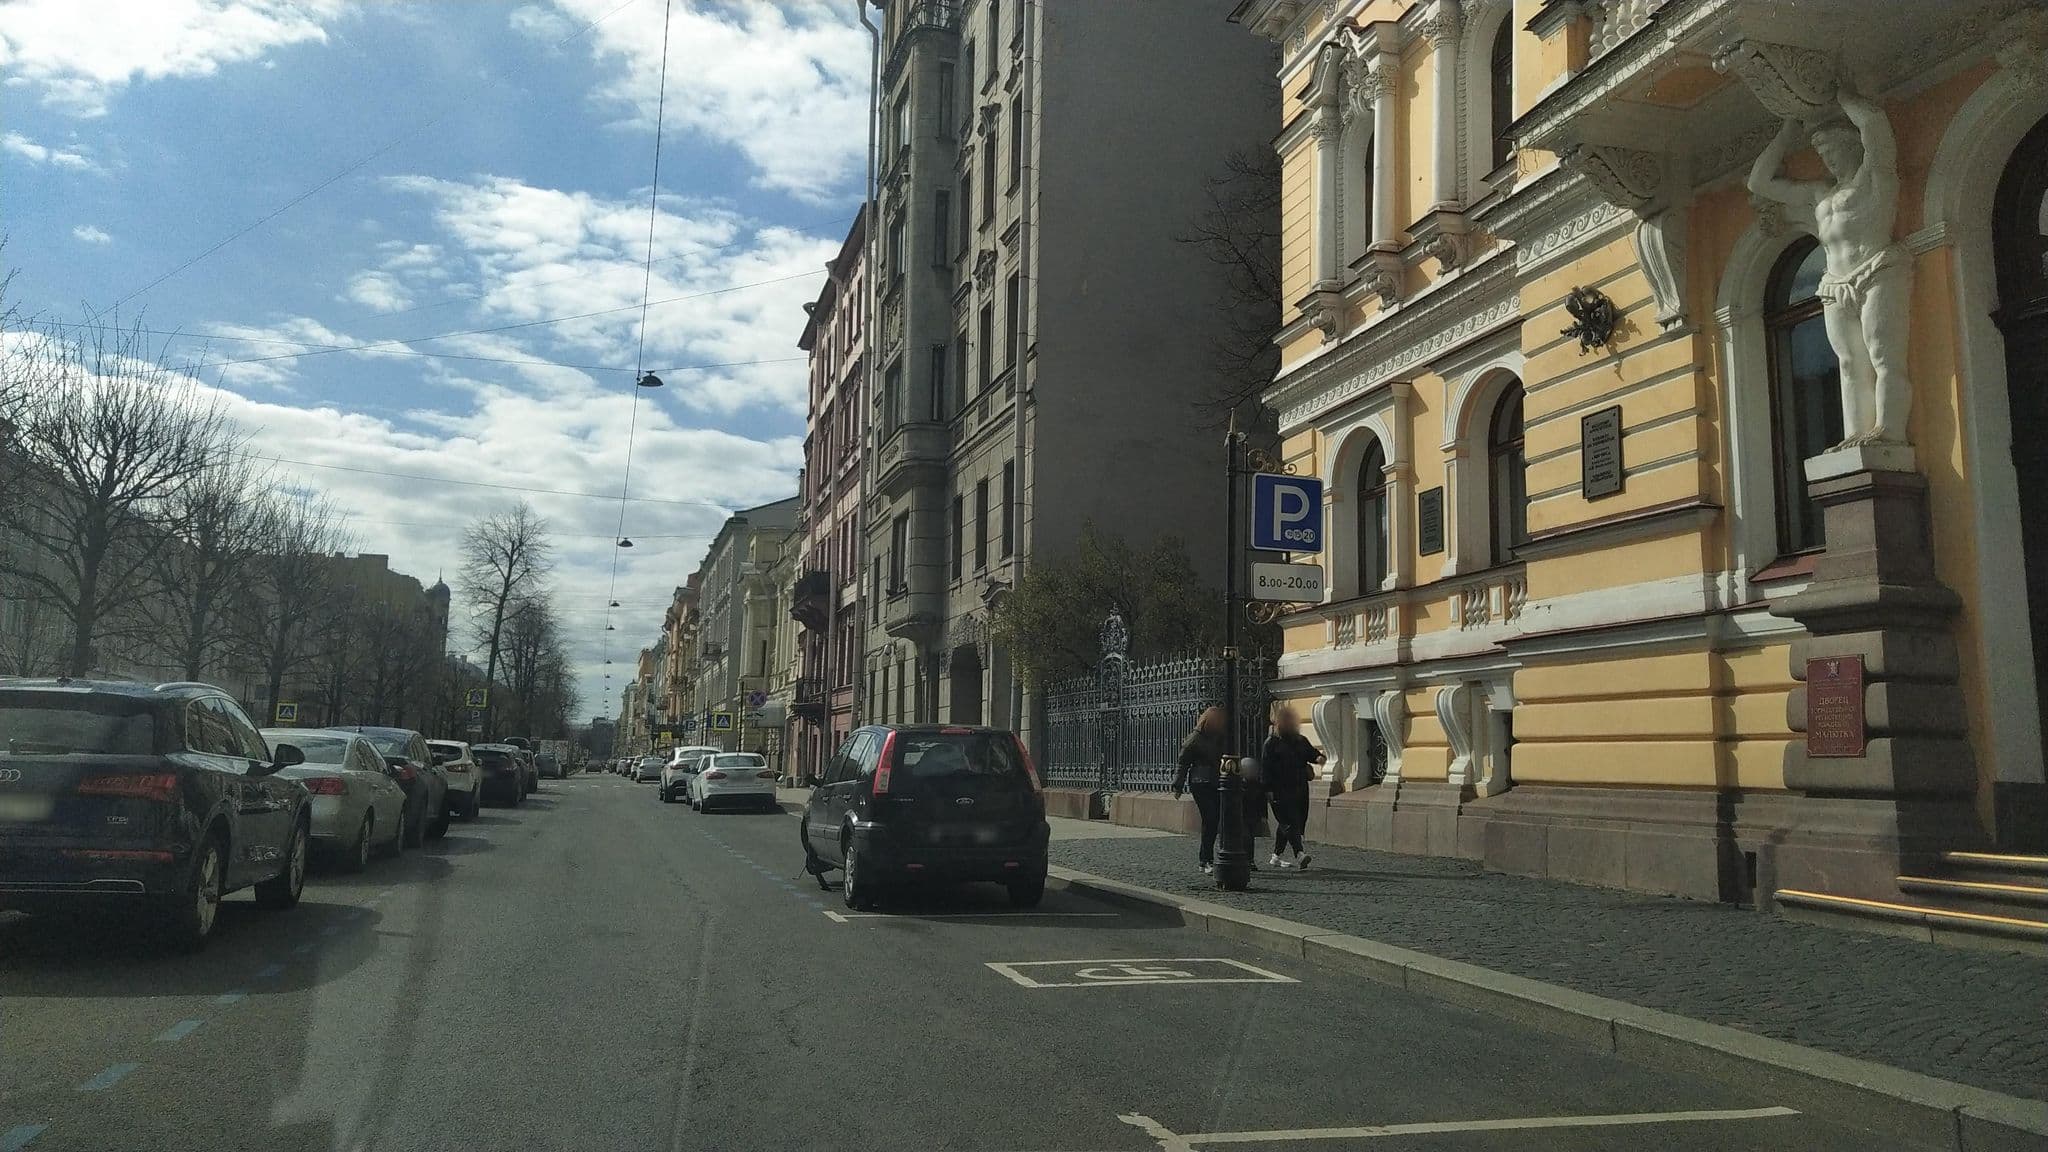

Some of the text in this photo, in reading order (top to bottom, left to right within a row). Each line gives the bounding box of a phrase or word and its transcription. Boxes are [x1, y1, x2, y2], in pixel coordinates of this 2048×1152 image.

[1273, 484, 1310, 541] P
[1303, 531, 1315, 540] 20
[1259, 575, 1319, 590] 8.00-20.00
[1818, 696, 1849, 705] ДВОРЕЦ
